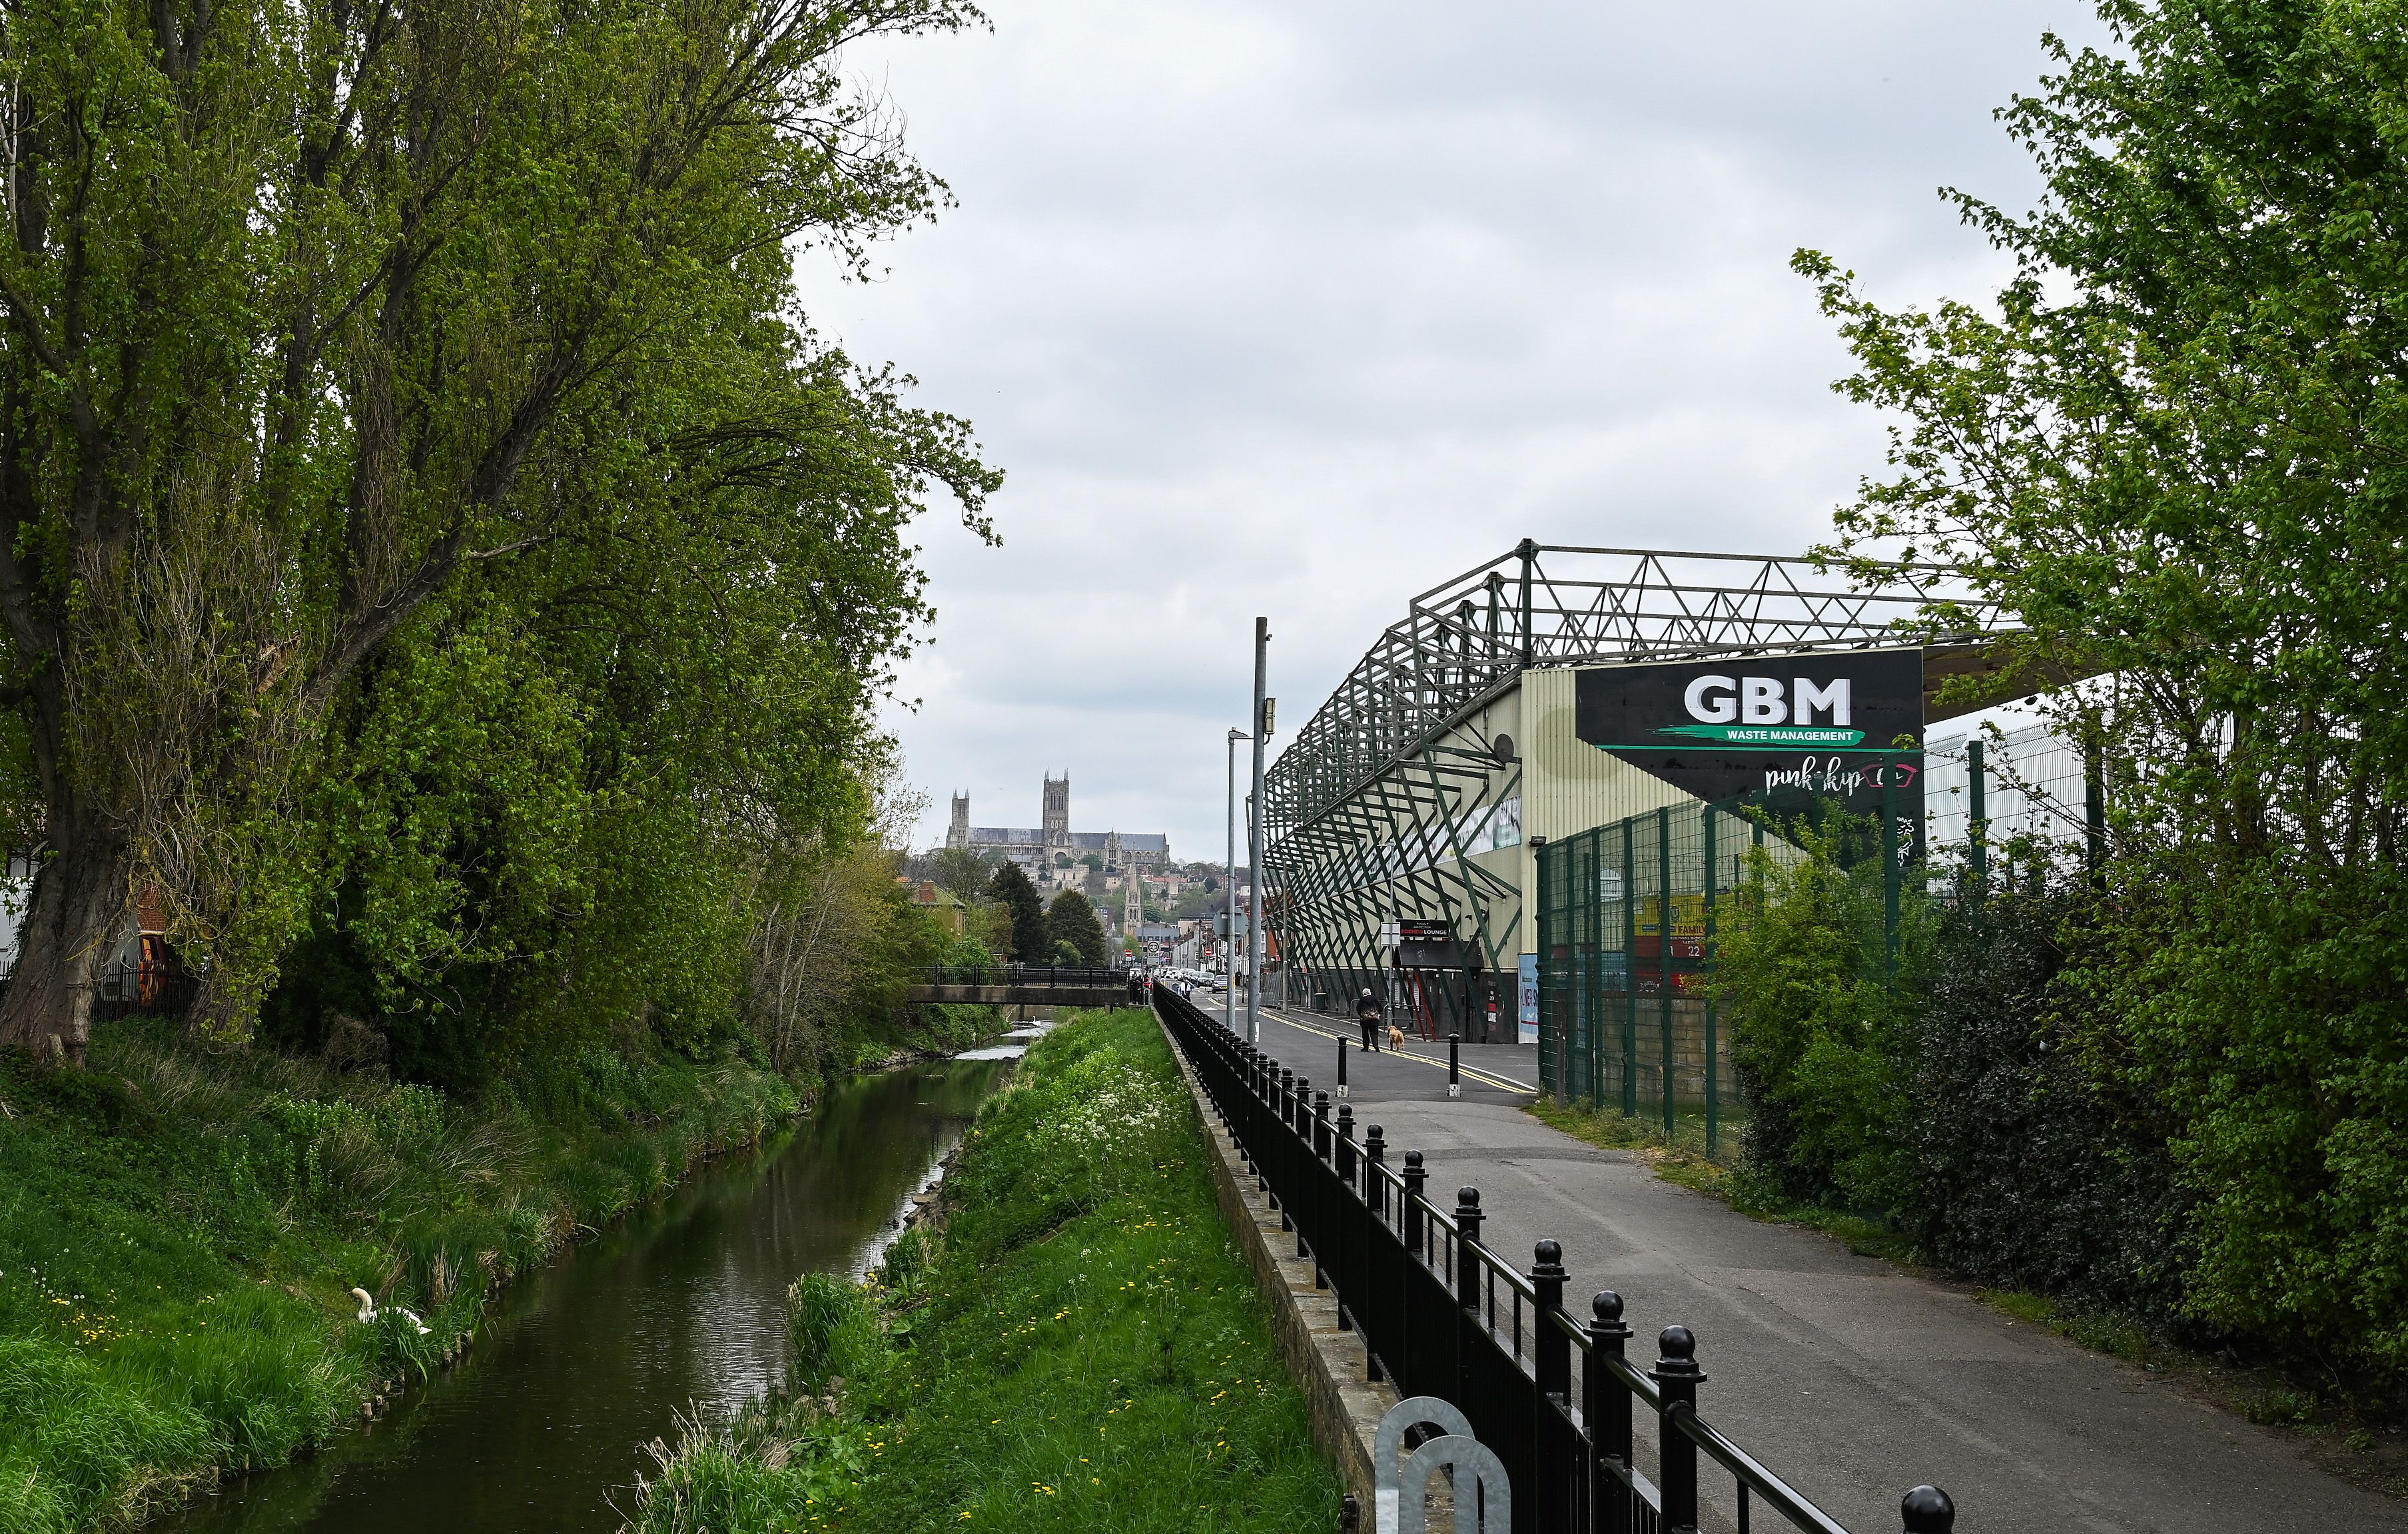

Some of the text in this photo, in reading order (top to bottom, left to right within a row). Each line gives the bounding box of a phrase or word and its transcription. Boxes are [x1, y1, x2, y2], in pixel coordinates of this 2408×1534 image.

[1684, 675, 1851, 726] GBM
[1727, 730, 1853, 741] WASTE MANAGEMENT
[1765, 755, 1816, 797] pink
[1688, 945, 1700, 957] 22
